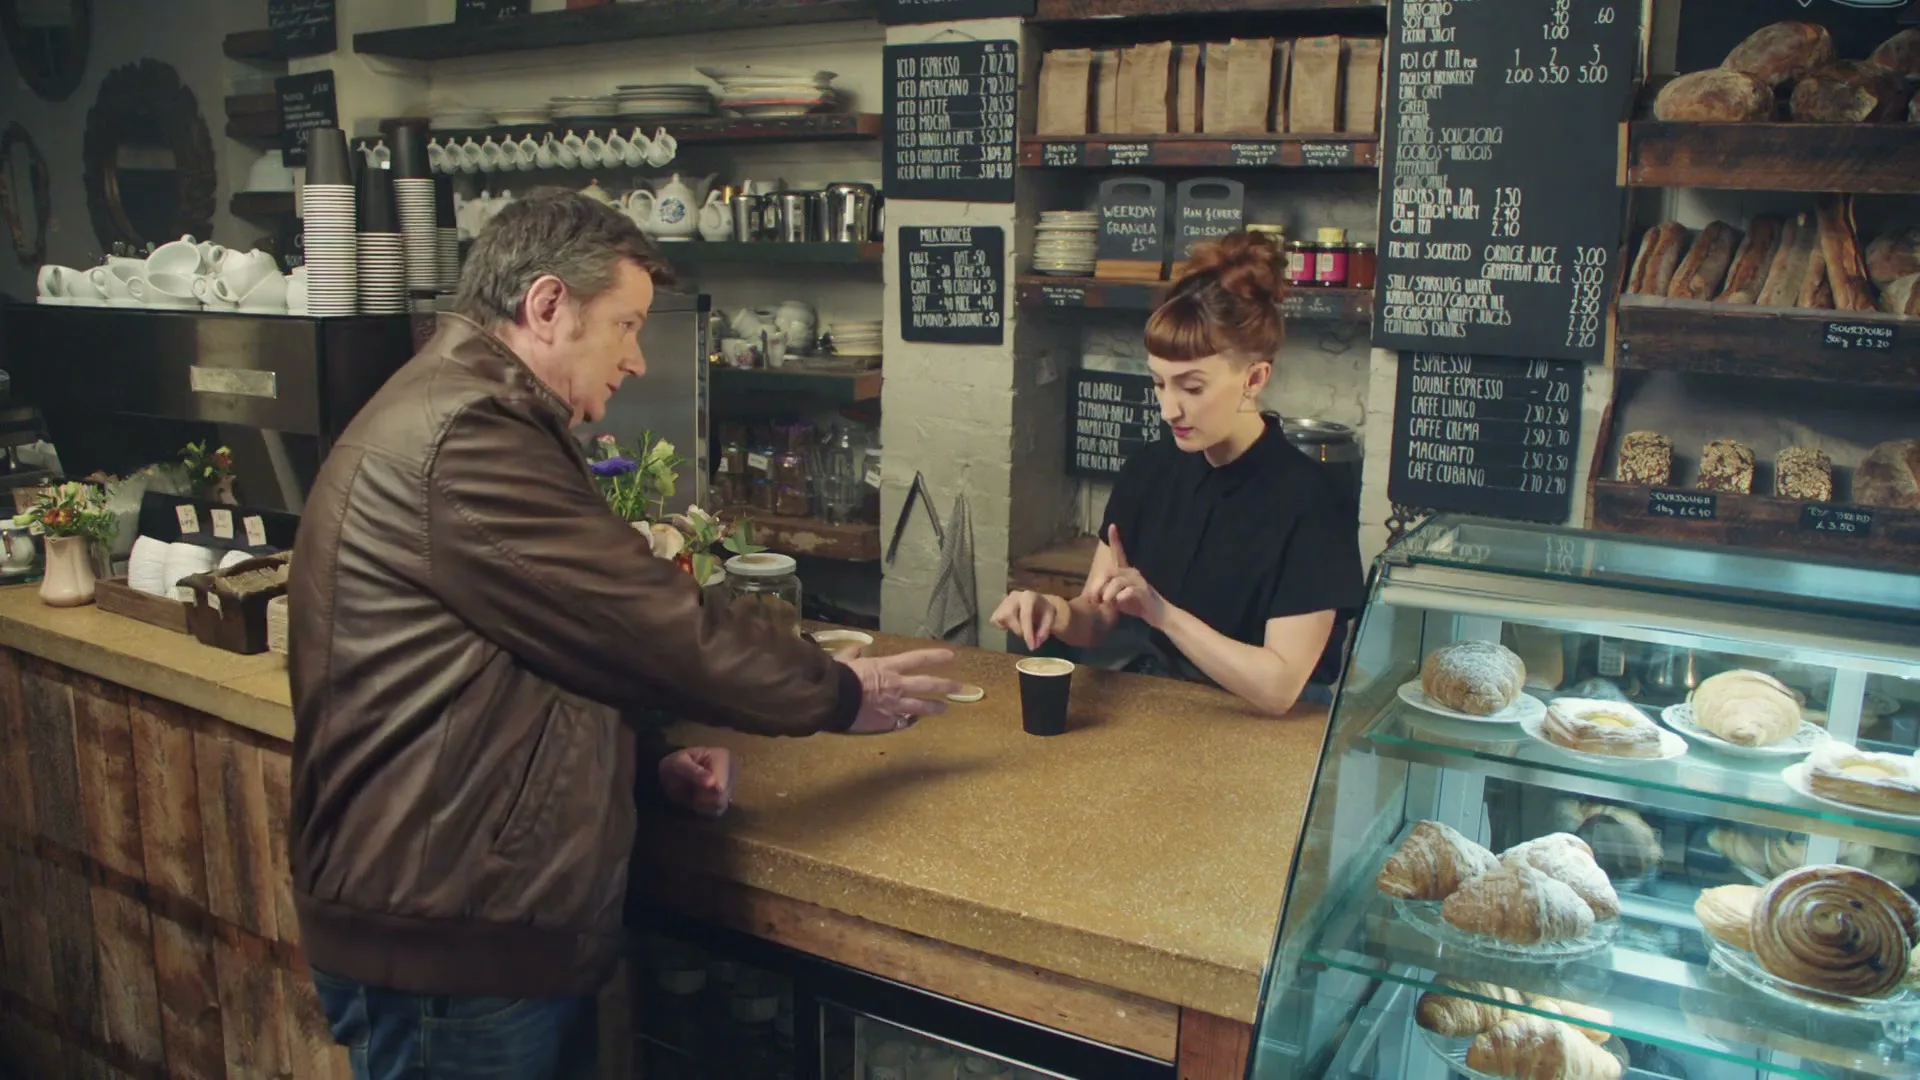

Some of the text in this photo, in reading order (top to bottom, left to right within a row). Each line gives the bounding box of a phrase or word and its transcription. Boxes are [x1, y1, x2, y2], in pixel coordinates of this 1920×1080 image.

[1594, 7, 1615, 24] .60
[1402, 24, 1569, 43] EXTRA SHOT 1.00
[1400, 44, 1600, 69] POT OF TEA FOR 1 2 3
[897, 57, 916, 78] ICED
[920, 55, 960, 77] ESPRESSO
[1434, 70, 1475, 84] BREAKFAST
[1505, 68, 1533, 84] 2.00
[1539, 66, 1570, 84] 3.50
[1578, 65, 1608, 83] 5.00
[897, 80, 916, 98] ICED
[919, 79, 969, 97] AMERICANO
[897, 100, 916, 115] ICED
[919, 99, 949, 115] LATTE
[897, 116, 916, 131] ICED
[919, 115, 951, 131] MOCHA
[897, 133, 916, 147] ICED
[919, 131, 951, 146] VANILLA
[1439, 127, 1502, 143] SOUCHONG
[897, 150, 916, 164] ICED
[917, 148, 960, 163] CHOCOLATE
[897, 165, 915, 180] ICED
[936, 165, 962, 180] LATTE
[1496, 188, 1521, 207] 1.50
[1103, 205, 1156, 218] WEEKDAY
[1183, 207, 1201, 219] HAM
[1212, 208, 1241, 220] CHEESE
[920, 228, 972, 243] MILK CHOICES
[1106, 221, 1156, 234] GRANOLA
[1424, 243, 1471, 261] SQUEEZED
[1484, 245, 1524, 263] ORANGE
[1528, 246, 1557, 264] JUICE
[1573, 246, 1606, 266] 3.00
[1481, 263, 1604, 285] GRAPEFRUIT JUICE 3.00
[1465, 278, 1492, 294] WATER
[1574, 284, 1601, 301] 1.50
[1570, 299, 1599, 314] 2.50
[1476, 310, 1511, 325] JUICES
[1569, 315, 1598, 332] 2.20
[1829, 323, 1893, 338] SOURDOUGH
[1432, 322, 1466, 337] DRINKS
[1566, 332, 1596, 347] 2.20
[1413, 353, 1472, 374] ESPRESSO
[1412, 375, 1450, 396] DOUBLE
[1454, 380, 1503, 400] ESPRESSO
[1411, 396, 1438, 416] CAFFE
[1442, 399, 1475, 419] LUNGO
[1410, 418, 1442, 437] CAFFE
[1446, 421, 1480, 441] CREMA
[1408, 440, 1474, 465] MACCHIATO
[1408, 460, 1433, 482] CAFE
[1436, 464, 1485, 487] CUBANO
